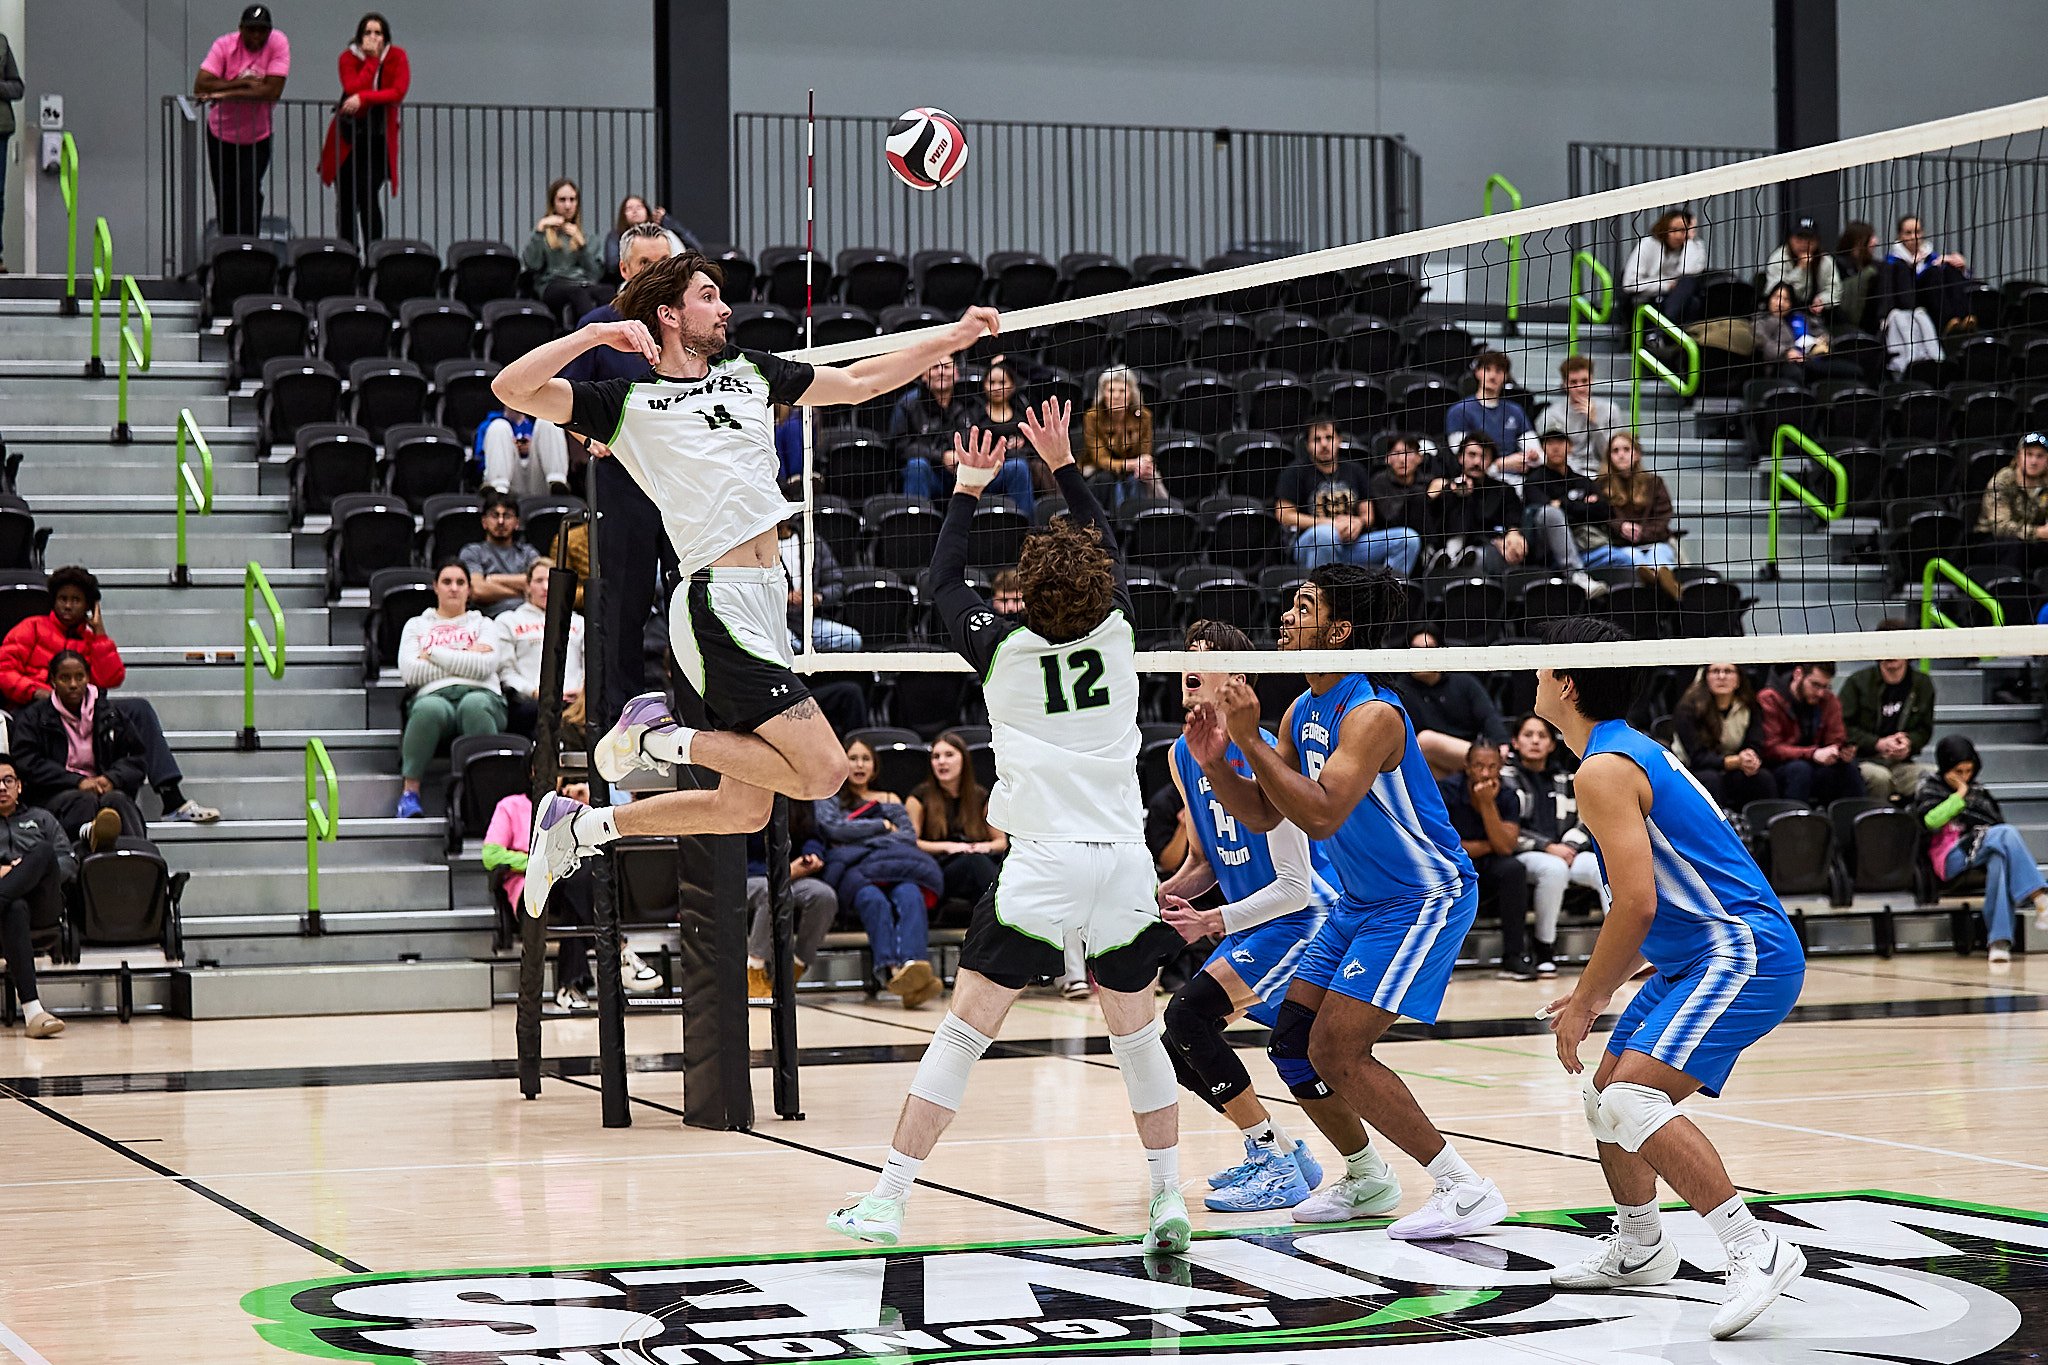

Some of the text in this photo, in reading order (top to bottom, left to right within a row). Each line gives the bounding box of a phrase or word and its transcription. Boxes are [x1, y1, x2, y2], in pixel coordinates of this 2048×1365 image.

[648, 376, 752, 411] WOLVES
[692, 404, 743, 430] 14
[1039, 647, 1110, 715] 12
[1208, 799, 1238, 842] 14
[497, 1306, 1281, 1365] ALGONQUIN
